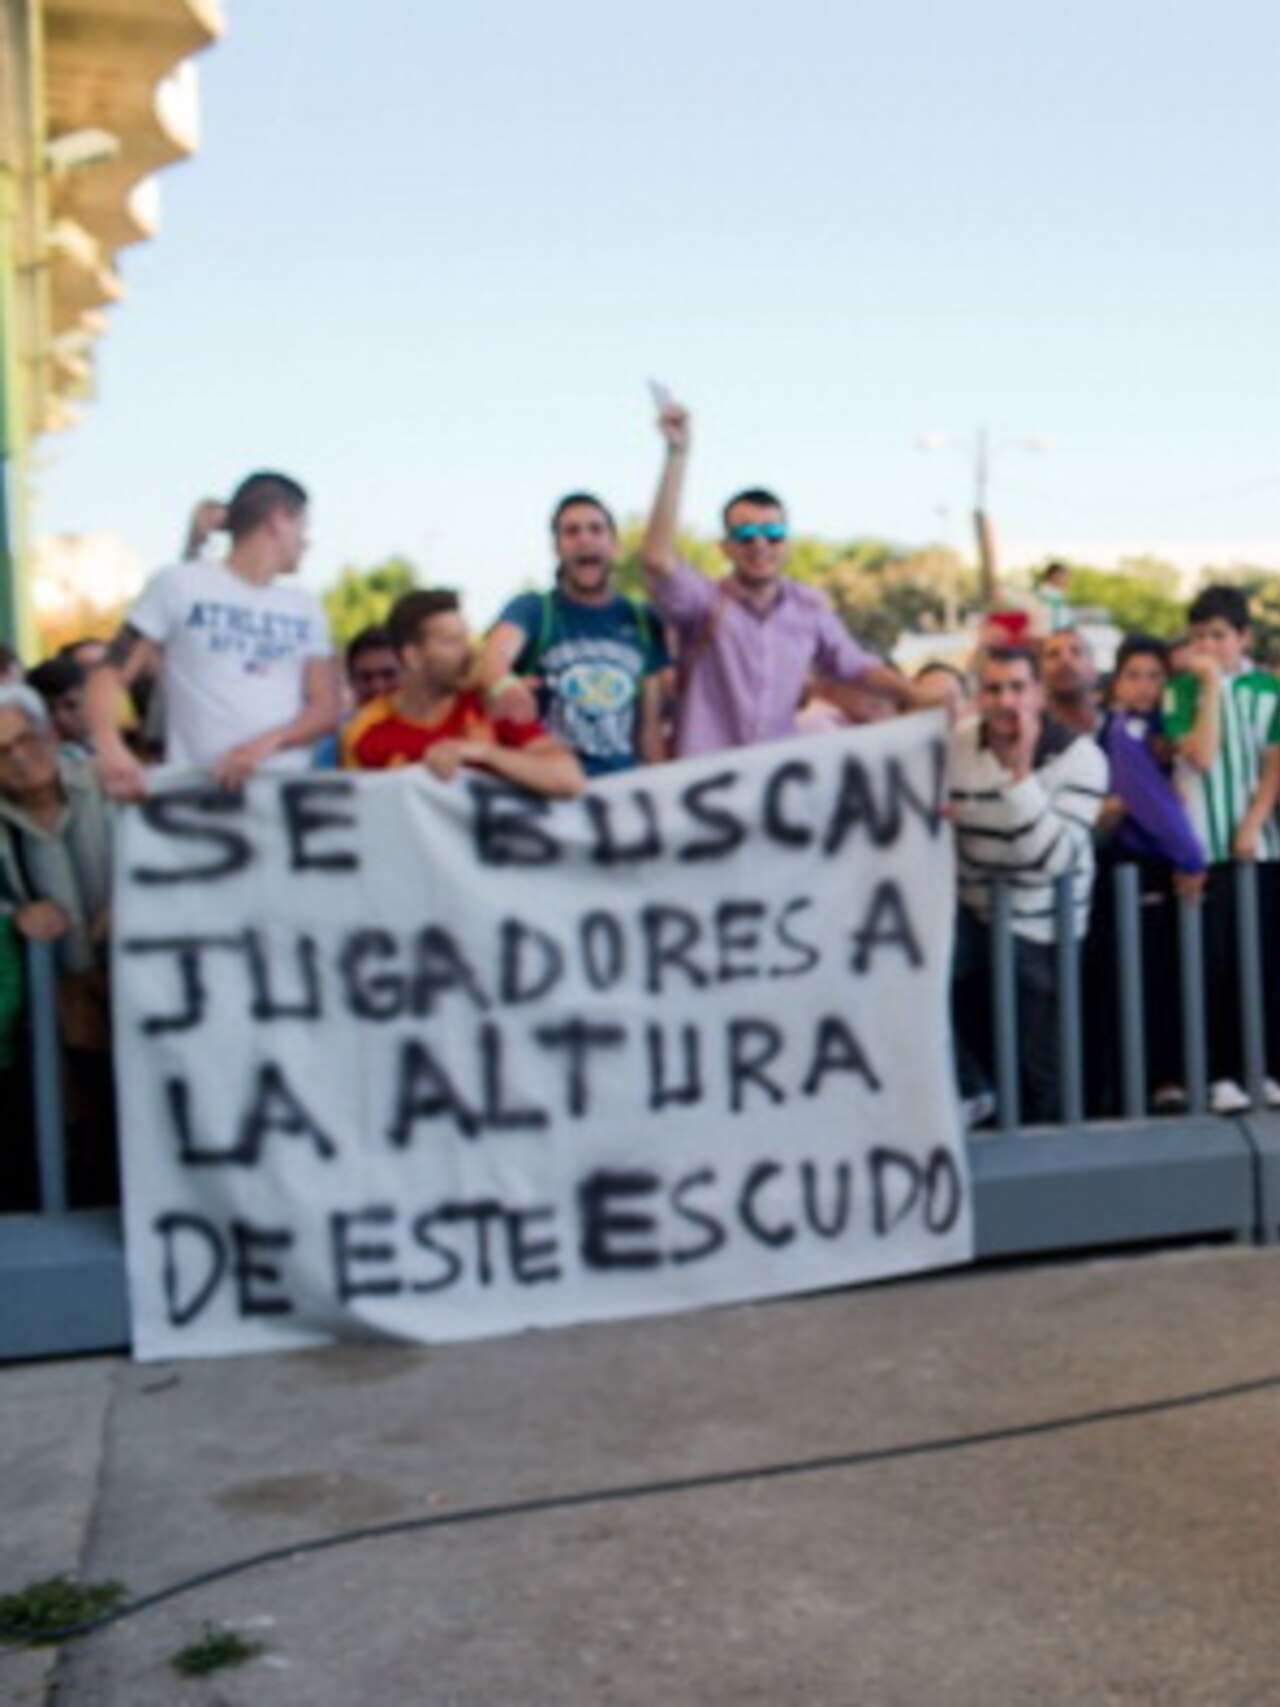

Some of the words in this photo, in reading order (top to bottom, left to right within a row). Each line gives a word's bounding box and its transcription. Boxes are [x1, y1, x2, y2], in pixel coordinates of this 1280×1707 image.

[131, 781, 359, 884] SE
[469, 738, 946, 866] BUSCAN
[121, 899, 820, 1035] JUGADORES
[850, 880, 924, 976] A
[168, 1062, 335, 1166] LA
[388, 1015, 881, 1149] ALTURA
[154, 1212, 294, 1328] DE
[330, 1199, 562, 1302] ESTE
[576, 1146, 961, 1270] ESCUDO
